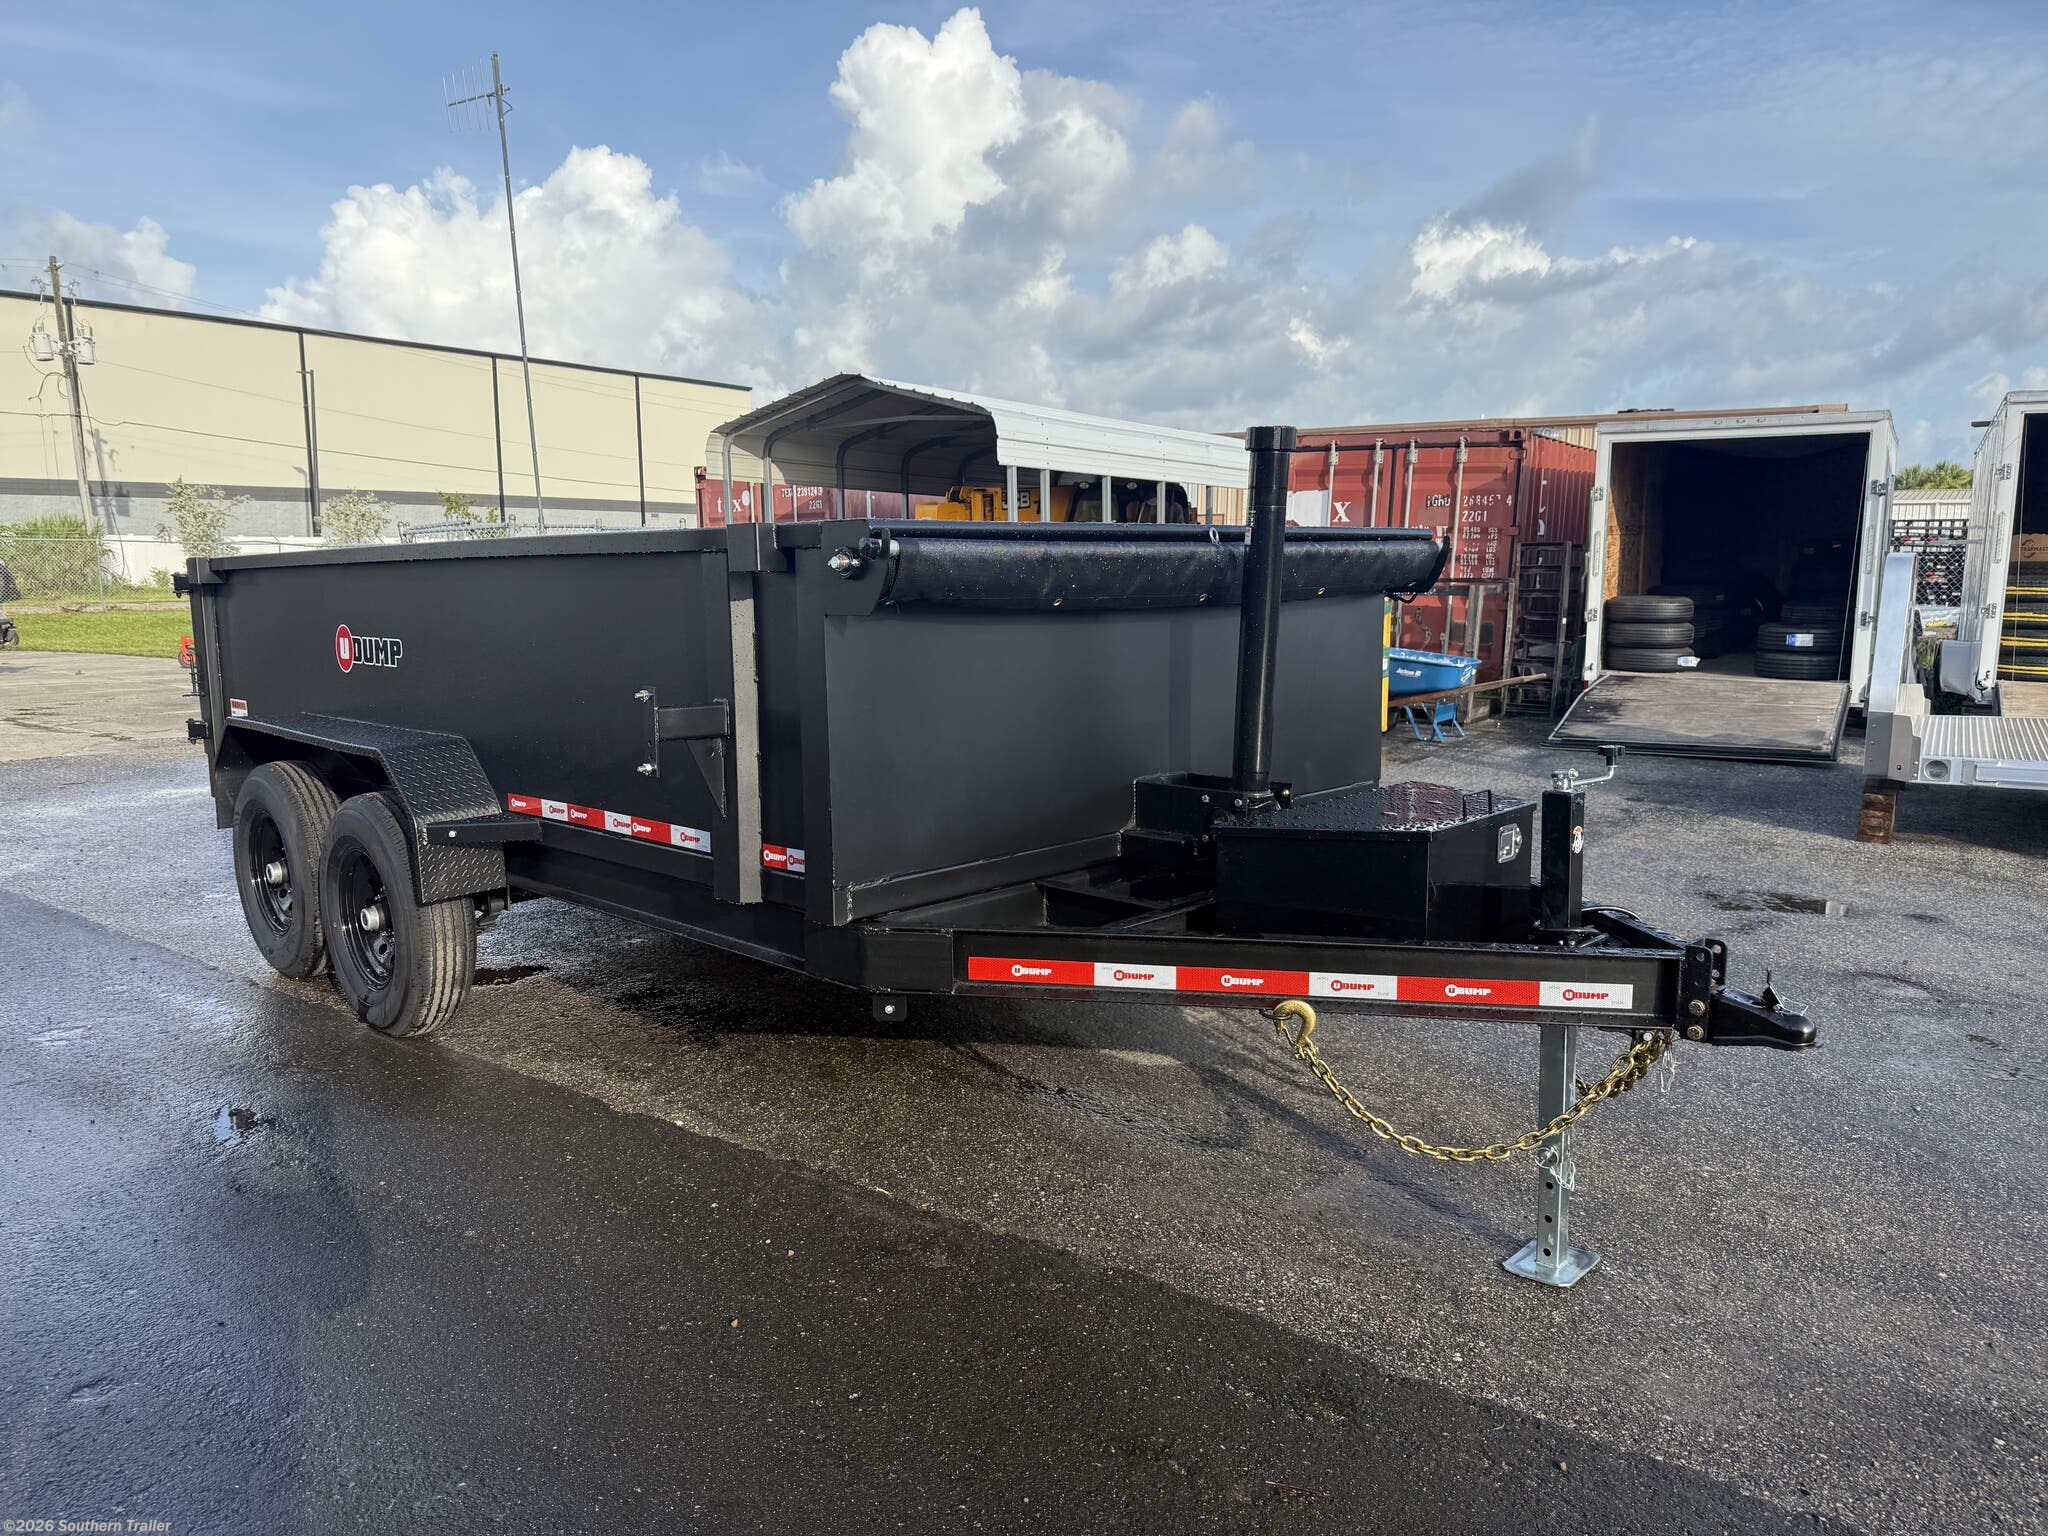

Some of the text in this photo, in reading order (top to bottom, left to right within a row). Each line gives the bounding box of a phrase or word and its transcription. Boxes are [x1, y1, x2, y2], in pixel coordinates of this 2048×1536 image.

[1506, 494, 1513, 507] 4
[336, 627, 403, 671] UDUMP
[1011, 964, 1609, 1001] UDUMP UDUMP UDUMP UDUMP UDUMP UDUMP
